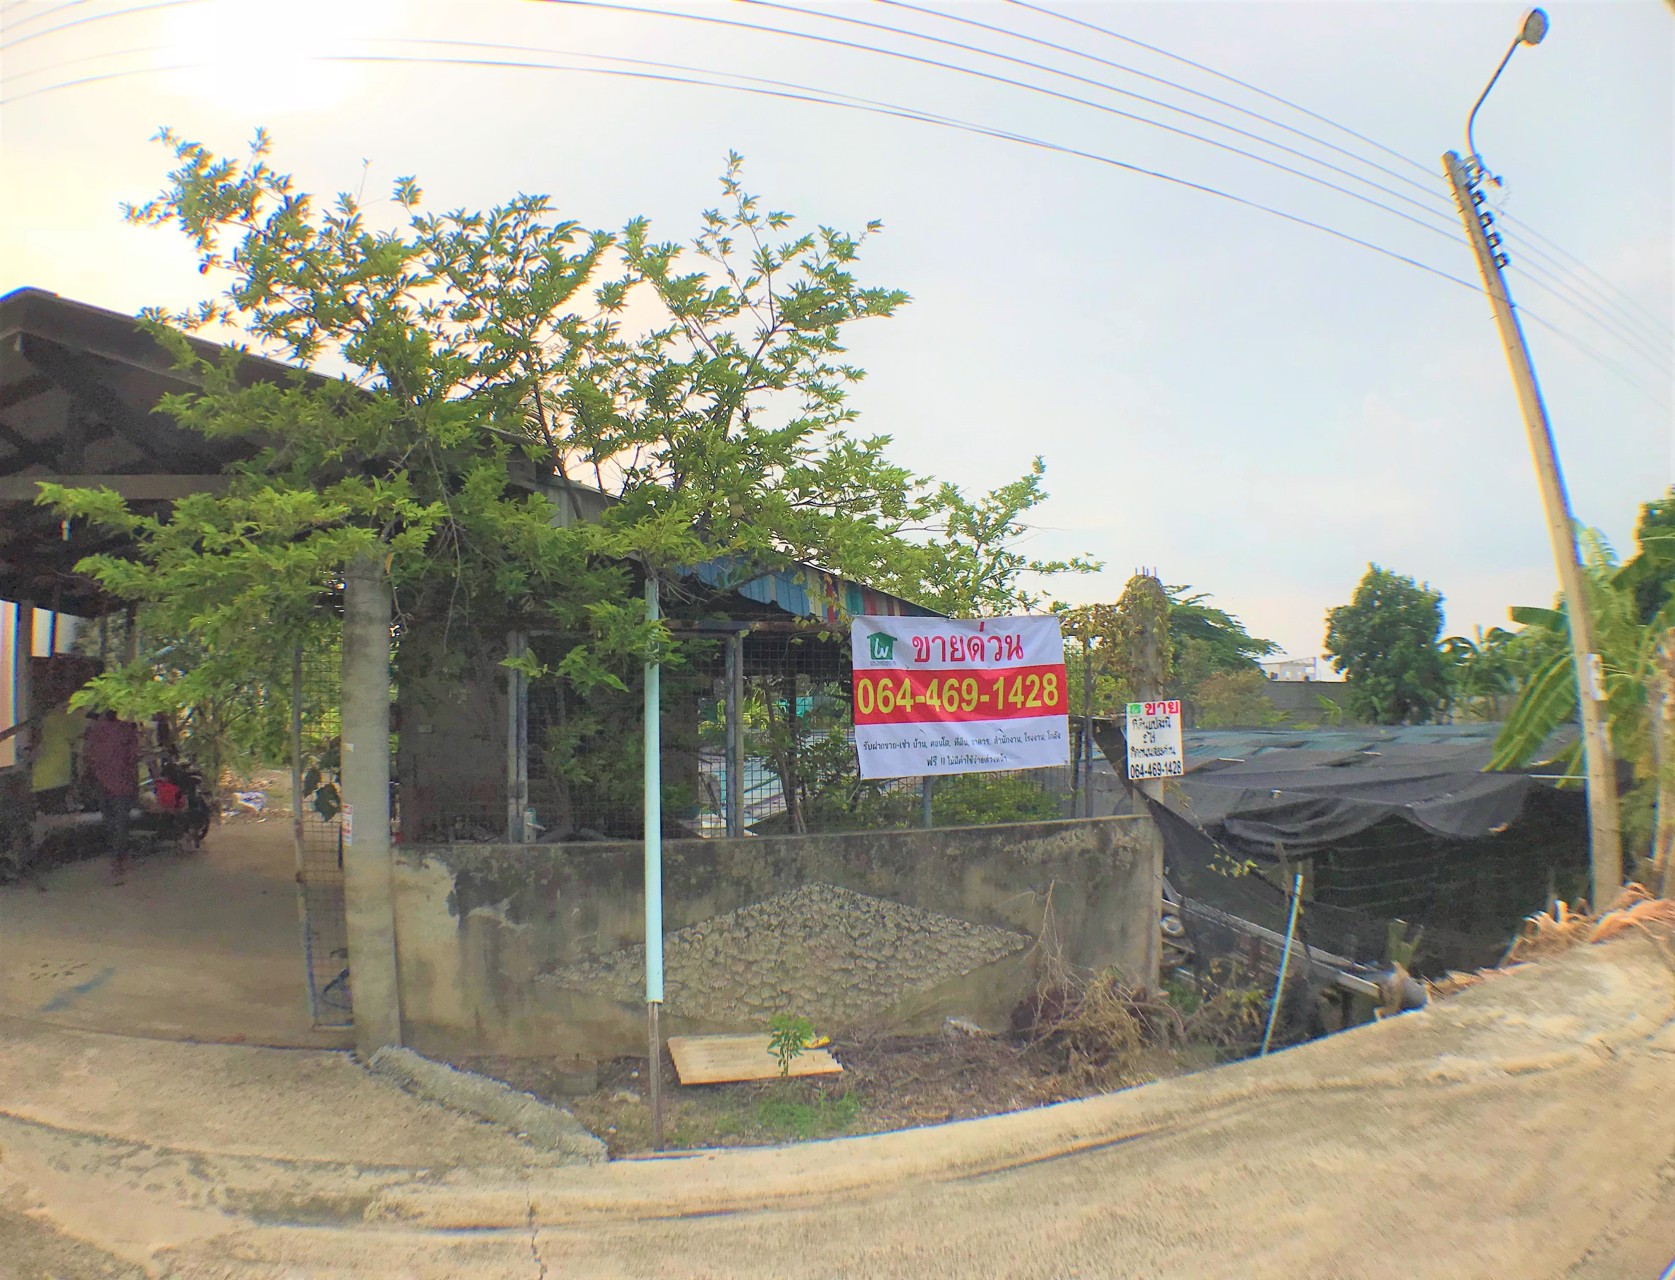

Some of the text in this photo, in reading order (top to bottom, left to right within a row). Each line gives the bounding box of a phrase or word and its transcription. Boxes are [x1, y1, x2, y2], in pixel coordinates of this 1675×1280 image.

[912, 621, 1024, 663] ขายด่วน
[857, 672, 1059, 715] 064-469-1428
[1144, 701, 1179, 716] ขาย
[913, 738, 927, 749] บ้าน,
[926, 755, 938, 767] ฟรี
[1130, 760, 1182, 779] 064-469-1428
